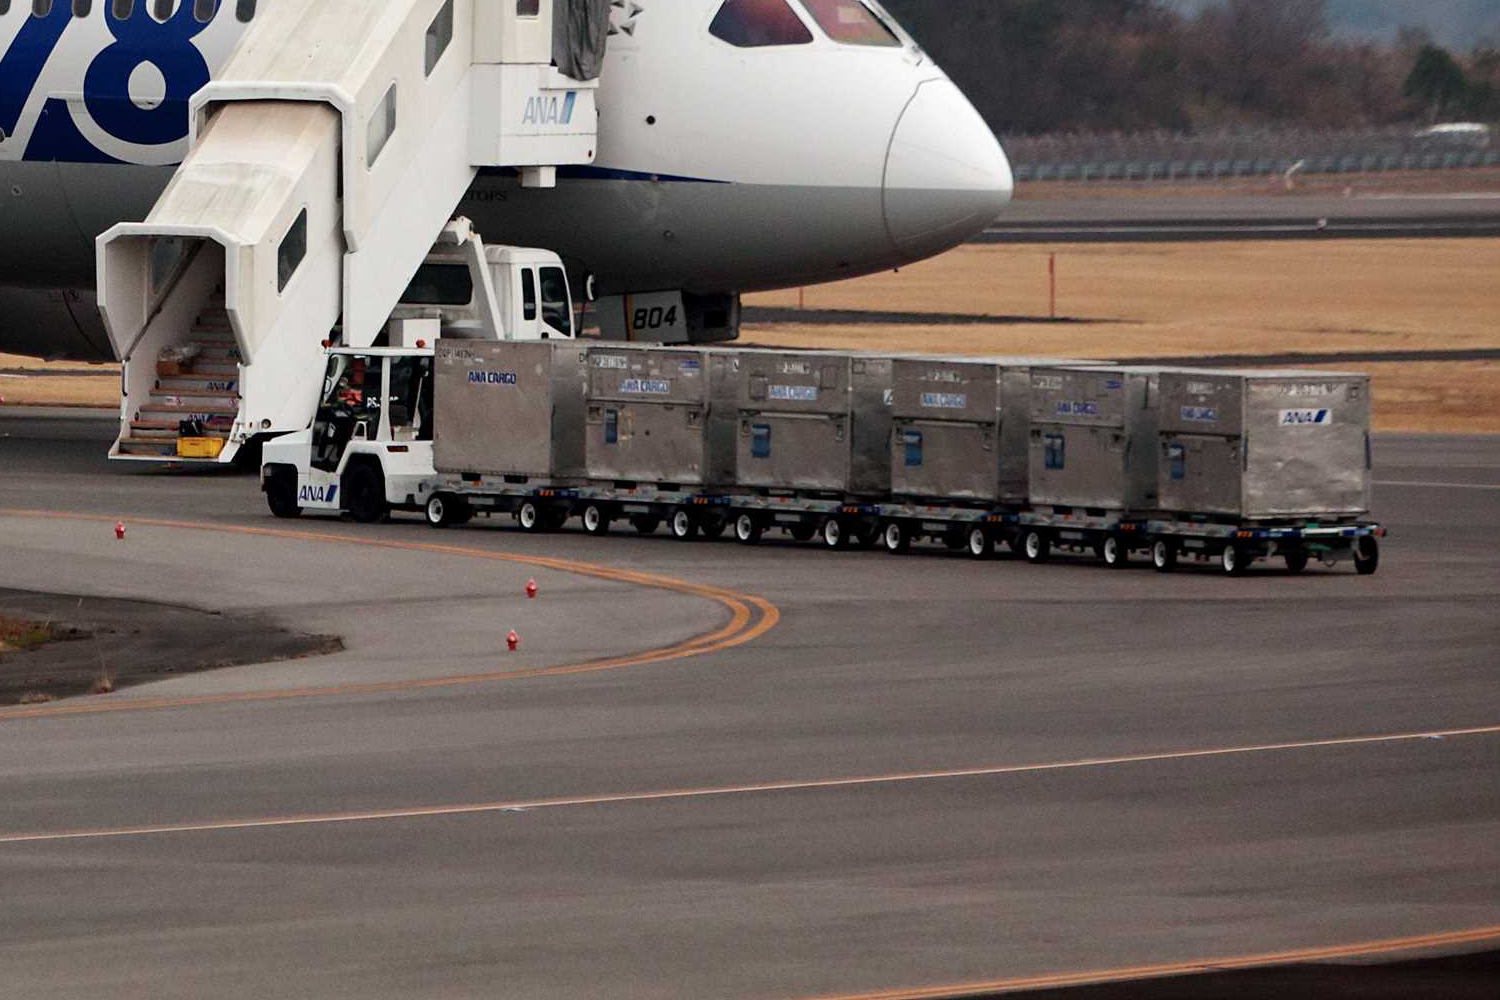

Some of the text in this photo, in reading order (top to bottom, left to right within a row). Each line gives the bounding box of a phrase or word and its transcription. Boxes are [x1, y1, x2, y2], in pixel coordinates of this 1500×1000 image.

[523, 96, 557, 125] ANA
[633, 306, 677, 330] 804
[468, 371, 517, 384] ANA CARGO
[1283, 412, 1311, 424] ANA
[299, 485, 325, 500] ANA
